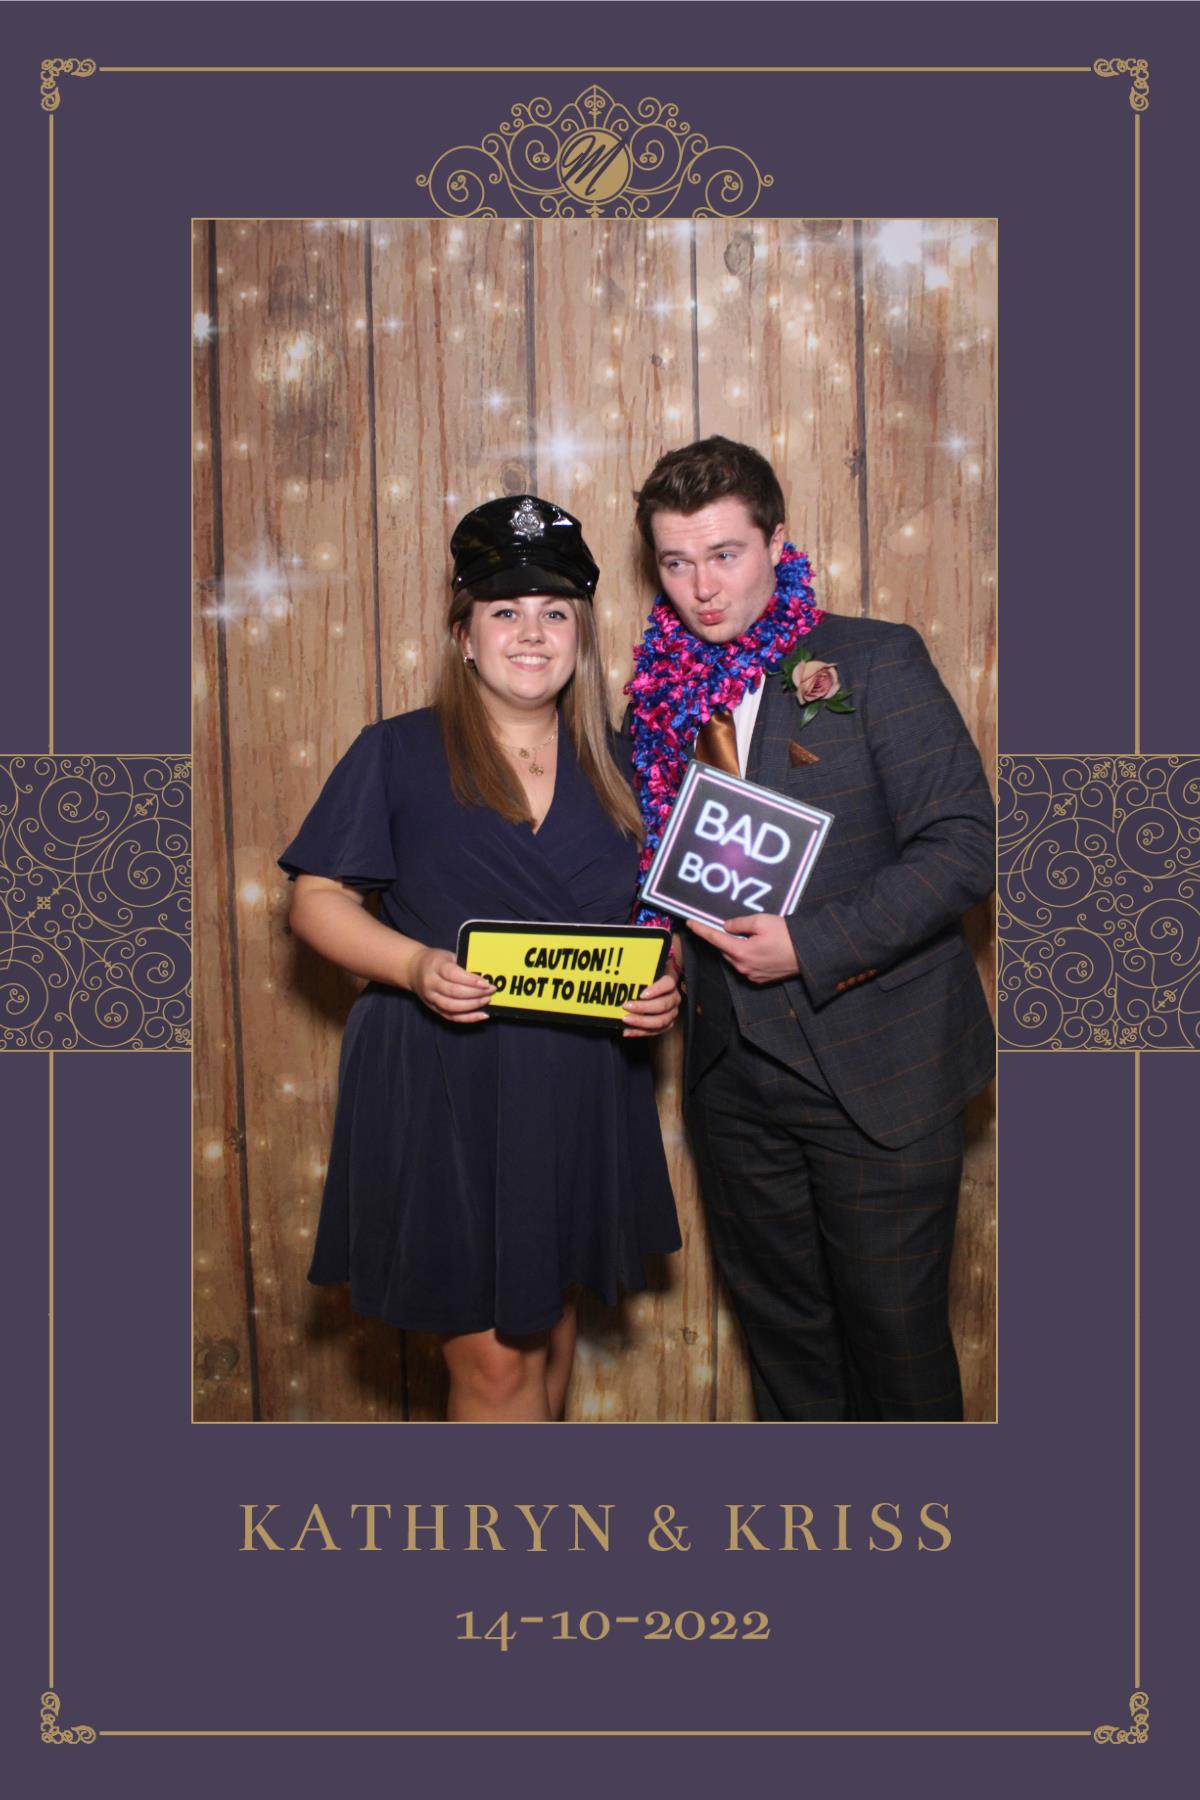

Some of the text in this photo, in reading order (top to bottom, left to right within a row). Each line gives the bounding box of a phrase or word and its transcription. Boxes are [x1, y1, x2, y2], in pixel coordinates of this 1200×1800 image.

[694, 799, 791, 864] BAD
[677, 851, 773, 912] BOYZ
[524, 947, 624, 976] CAUTION!!
[469, 971, 507, 993] OO
[509, 975, 548, 999] HOT
[551, 979, 575, 1001] TO
